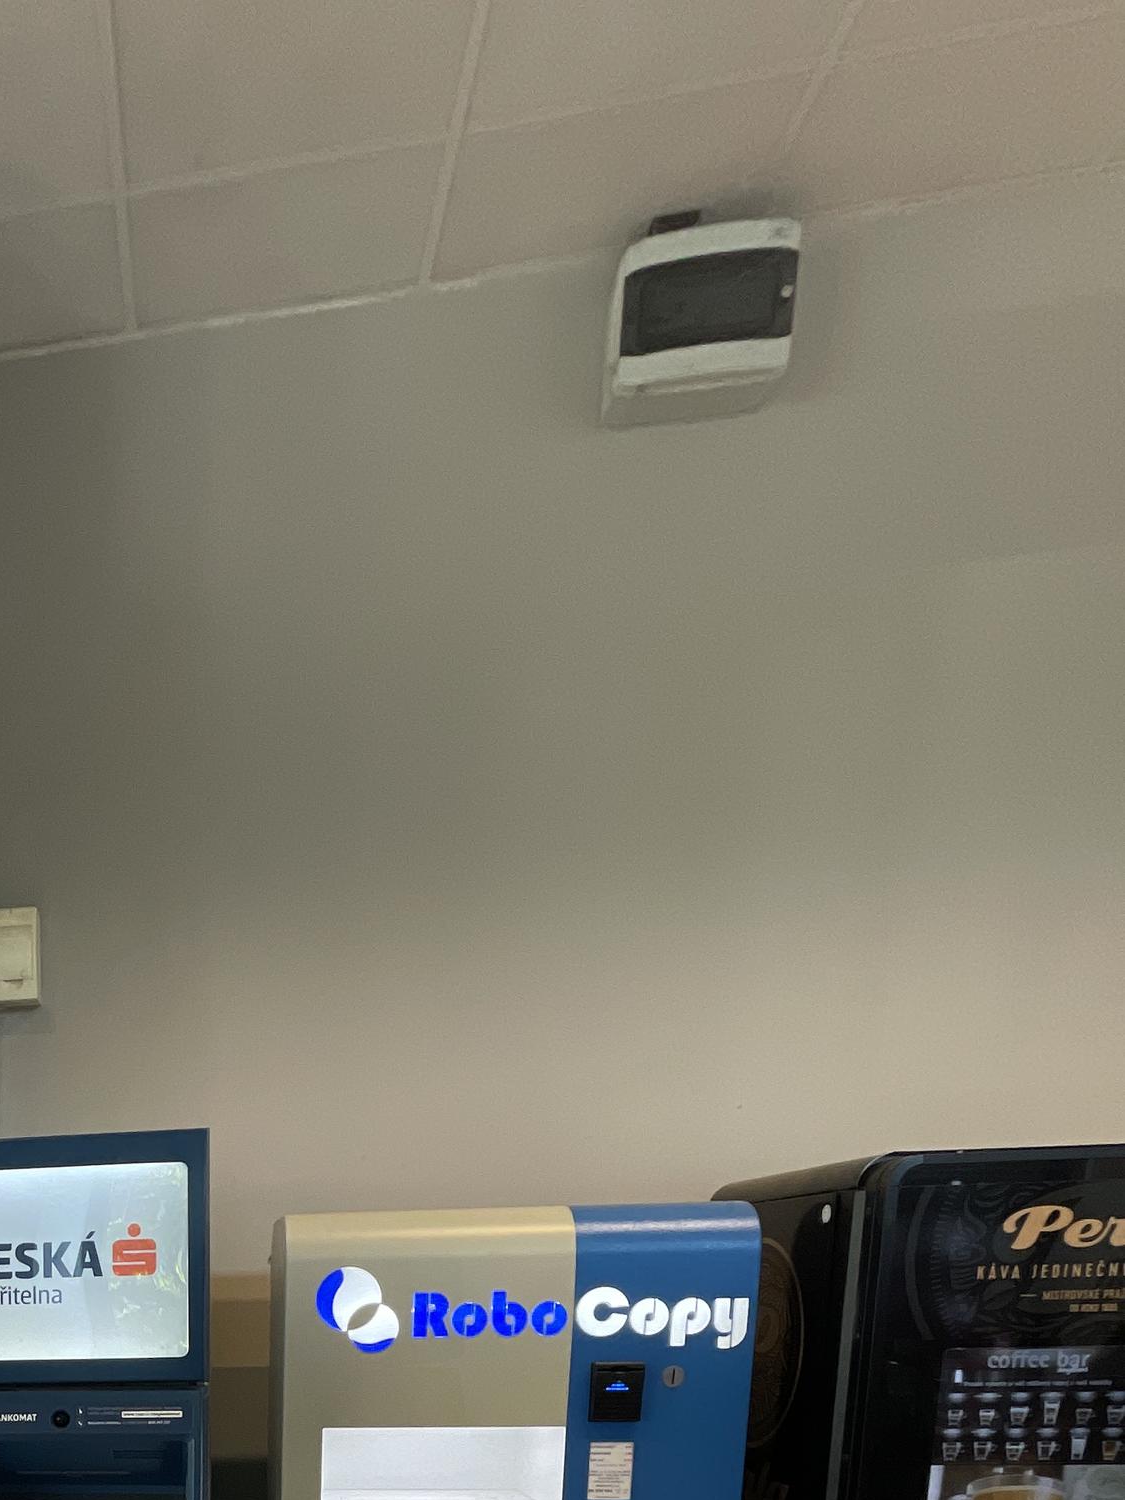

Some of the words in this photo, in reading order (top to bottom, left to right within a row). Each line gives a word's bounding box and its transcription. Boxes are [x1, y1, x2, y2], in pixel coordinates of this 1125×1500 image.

[976, 1262, 1021, 1281] KÁVA
[1031, 1260, 1125, 1279] JEDINEČN
[987, 1350, 1051, 1369] coffee
[1056, 1349, 1092, 1369] bar
